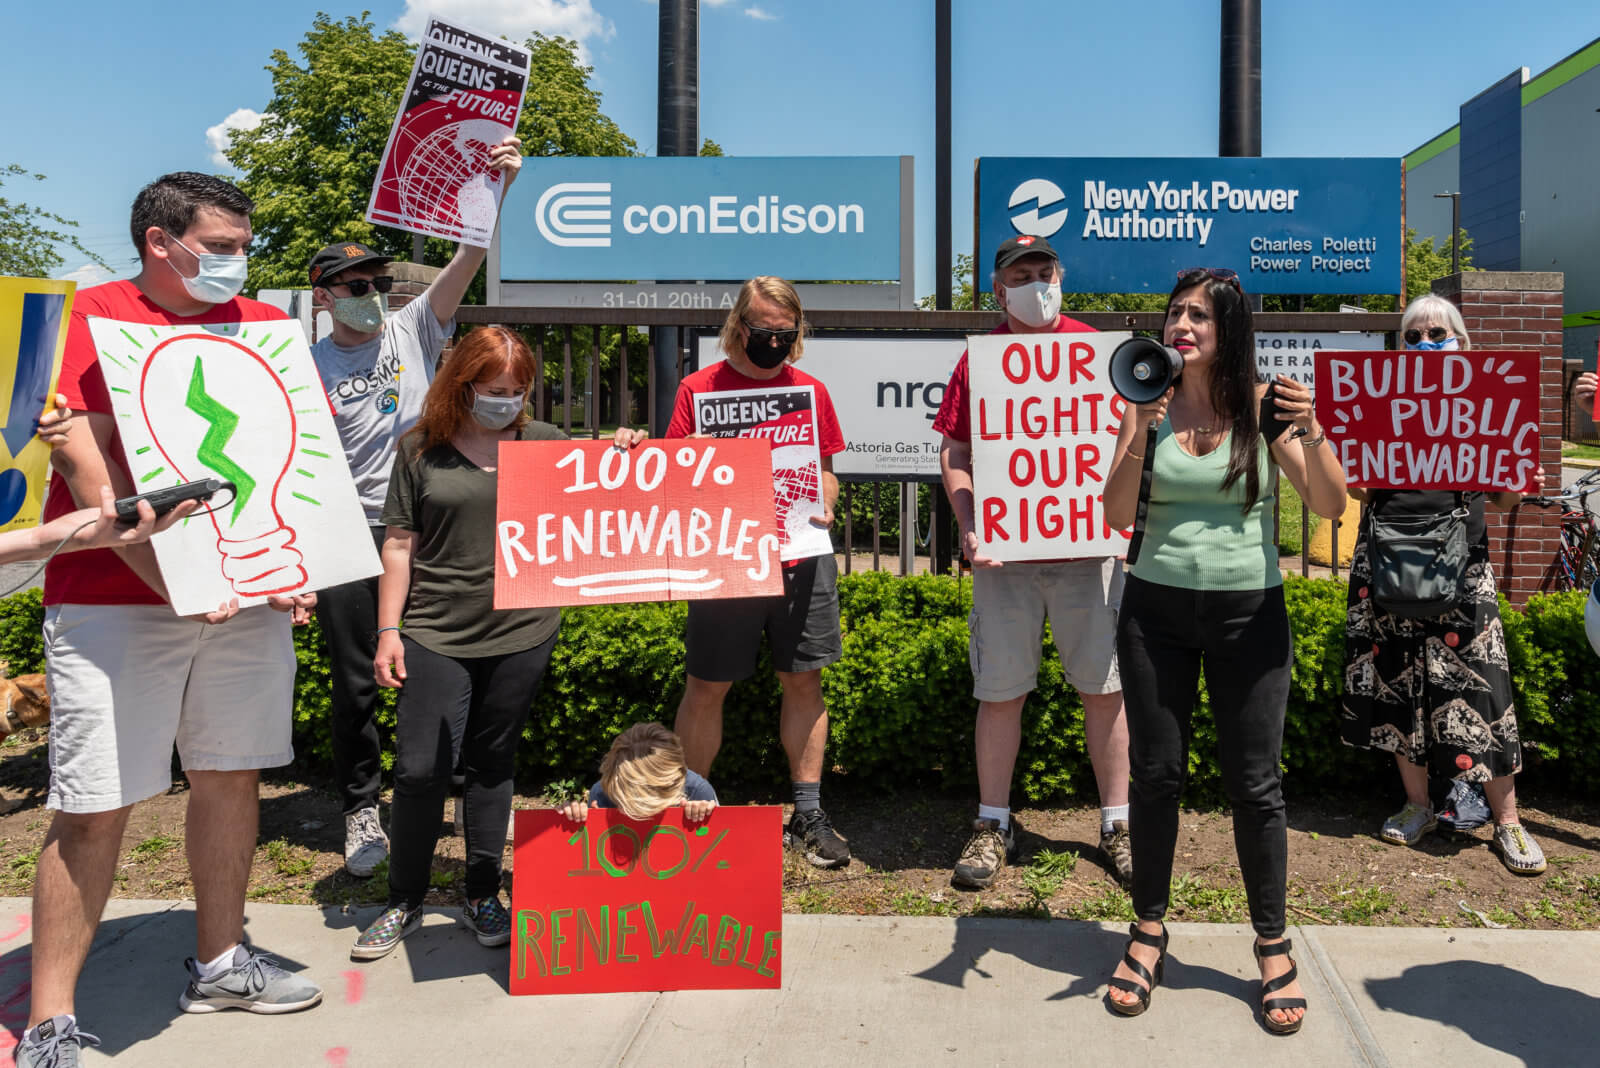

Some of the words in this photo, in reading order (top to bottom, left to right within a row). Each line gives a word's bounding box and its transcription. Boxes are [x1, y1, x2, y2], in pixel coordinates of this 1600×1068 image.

[421, 51, 496, 92] QUEENS
[432, 81, 450, 92] THE
[446, 89, 517, 122] FUTURE
[623, 196, 864, 234] conEdison
[1083, 209, 1213, 245] Authority
[1250, 237, 1312, 252] Charles
[1322, 237, 1376, 252] Poletti
[1250, 255, 1301, 271] Power
[1311, 255, 1371, 273] Project
[602, 292, 658, 308] 31-01
[668, 291, 712, 308] 20th
[1002, 341, 1095, 384] OUR
[1258, 339, 1322, 349] TORIA
[1258, 356, 1312, 366] NERA
[1330, 355, 1472, 402] BUILD
[701, 400, 781, 426] QUEENS
[979, 392, 1129, 440] LIGHTS
[1391, 398, 1539, 456] PUBLIC
[846, 442, 892, 453] Astoria
[895, 442, 919, 453] Gas
[875, 455, 919, 464] Generating
[1008, 443, 1103, 488] OUR
[1330, 439, 1535, 491] ENEWABLES
[555, 445, 735, 493] 100%
[498, 505, 780, 581] RENEWABLES
[567, 824, 731, 880] 100%
[517, 901, 782, 979] RENEWABLE
